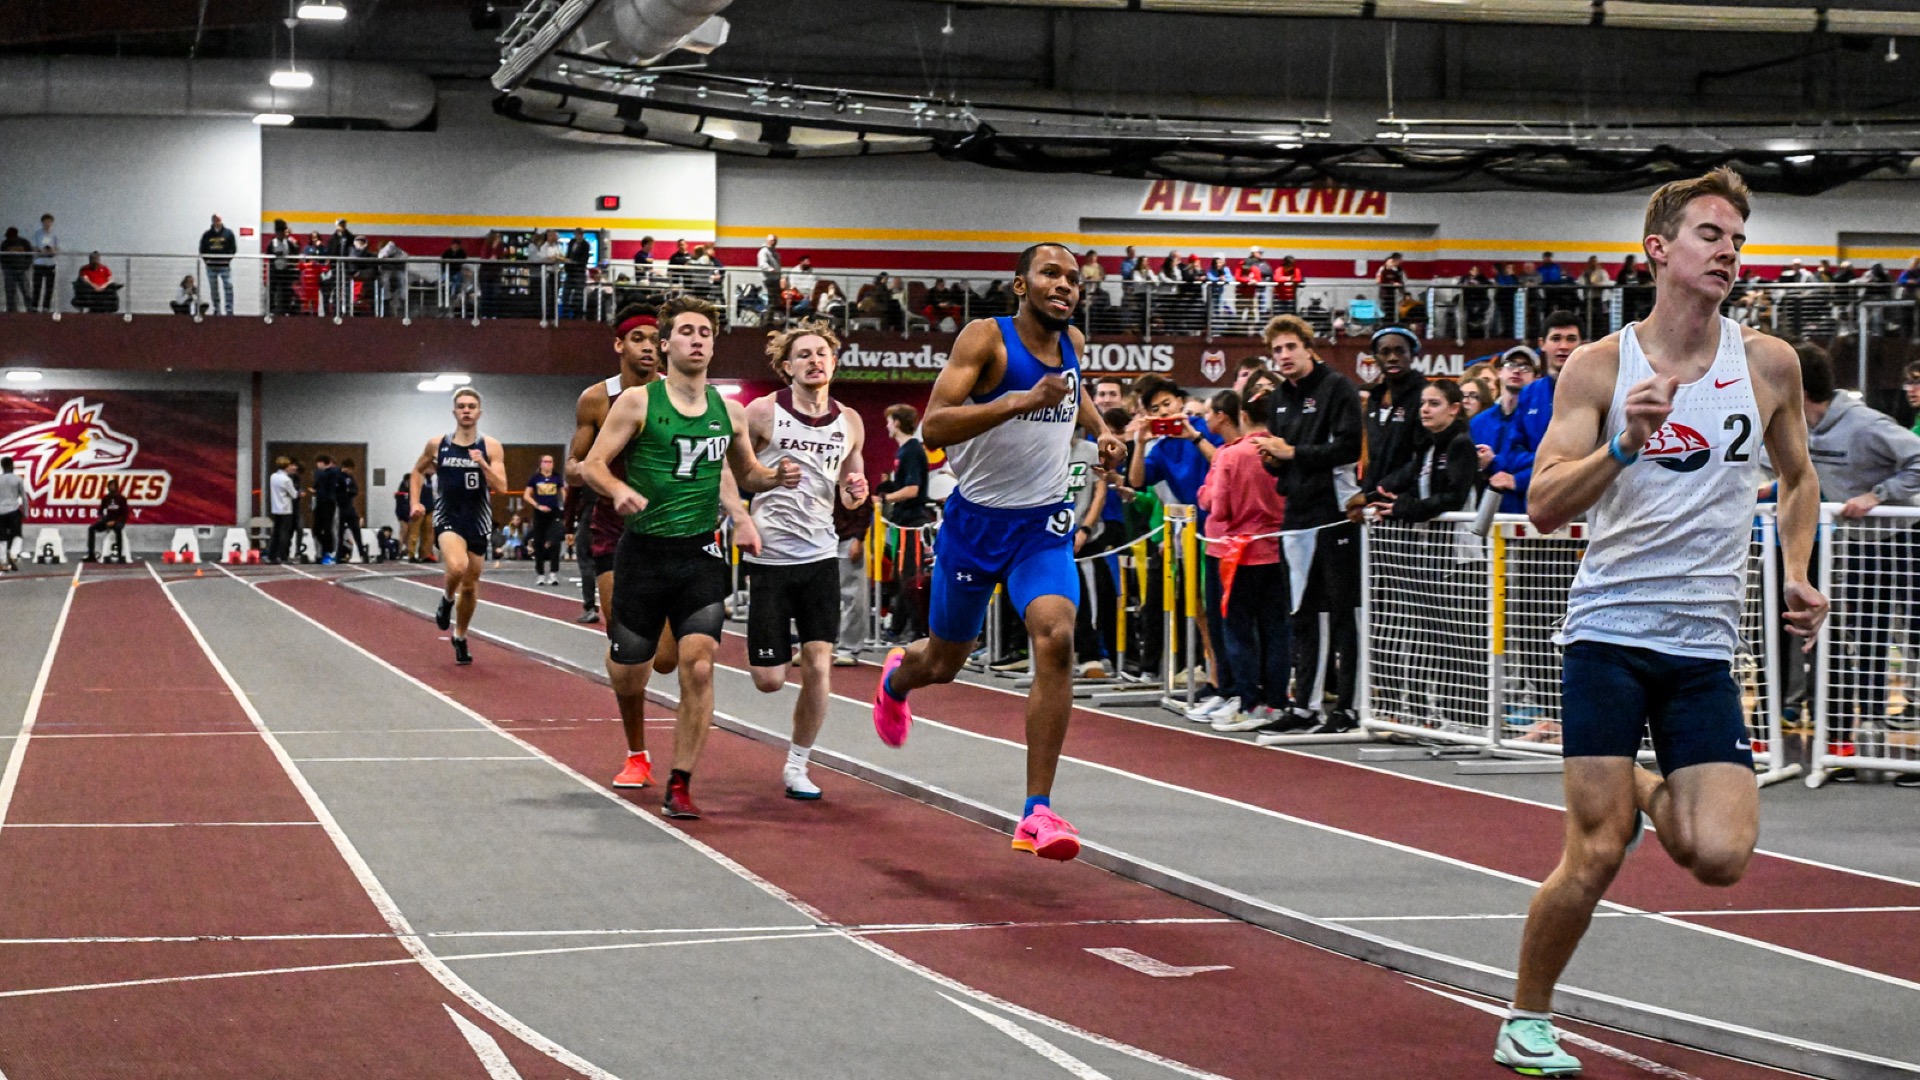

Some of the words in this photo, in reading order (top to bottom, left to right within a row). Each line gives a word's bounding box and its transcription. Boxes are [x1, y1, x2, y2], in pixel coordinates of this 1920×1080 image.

[1142, 180, 1388, 215] ALVERNIA
[839, 343, 948, 369] dwards
[708, 437, 727, 459] 10
[780, 438, 840, 454] EASTER
[1723, 413, 1751, 462] 2
[671, 434, 711, 479] Y
[825, 455, 840, 471] 11
[53, 474, 166, 500] WOLVES
[467, 473, 476, 487] 6
[30, 508, 142, 518] UNIVERY
[1051, 509, 1071, 534] 9
[43, 543, 54, 557] 6
